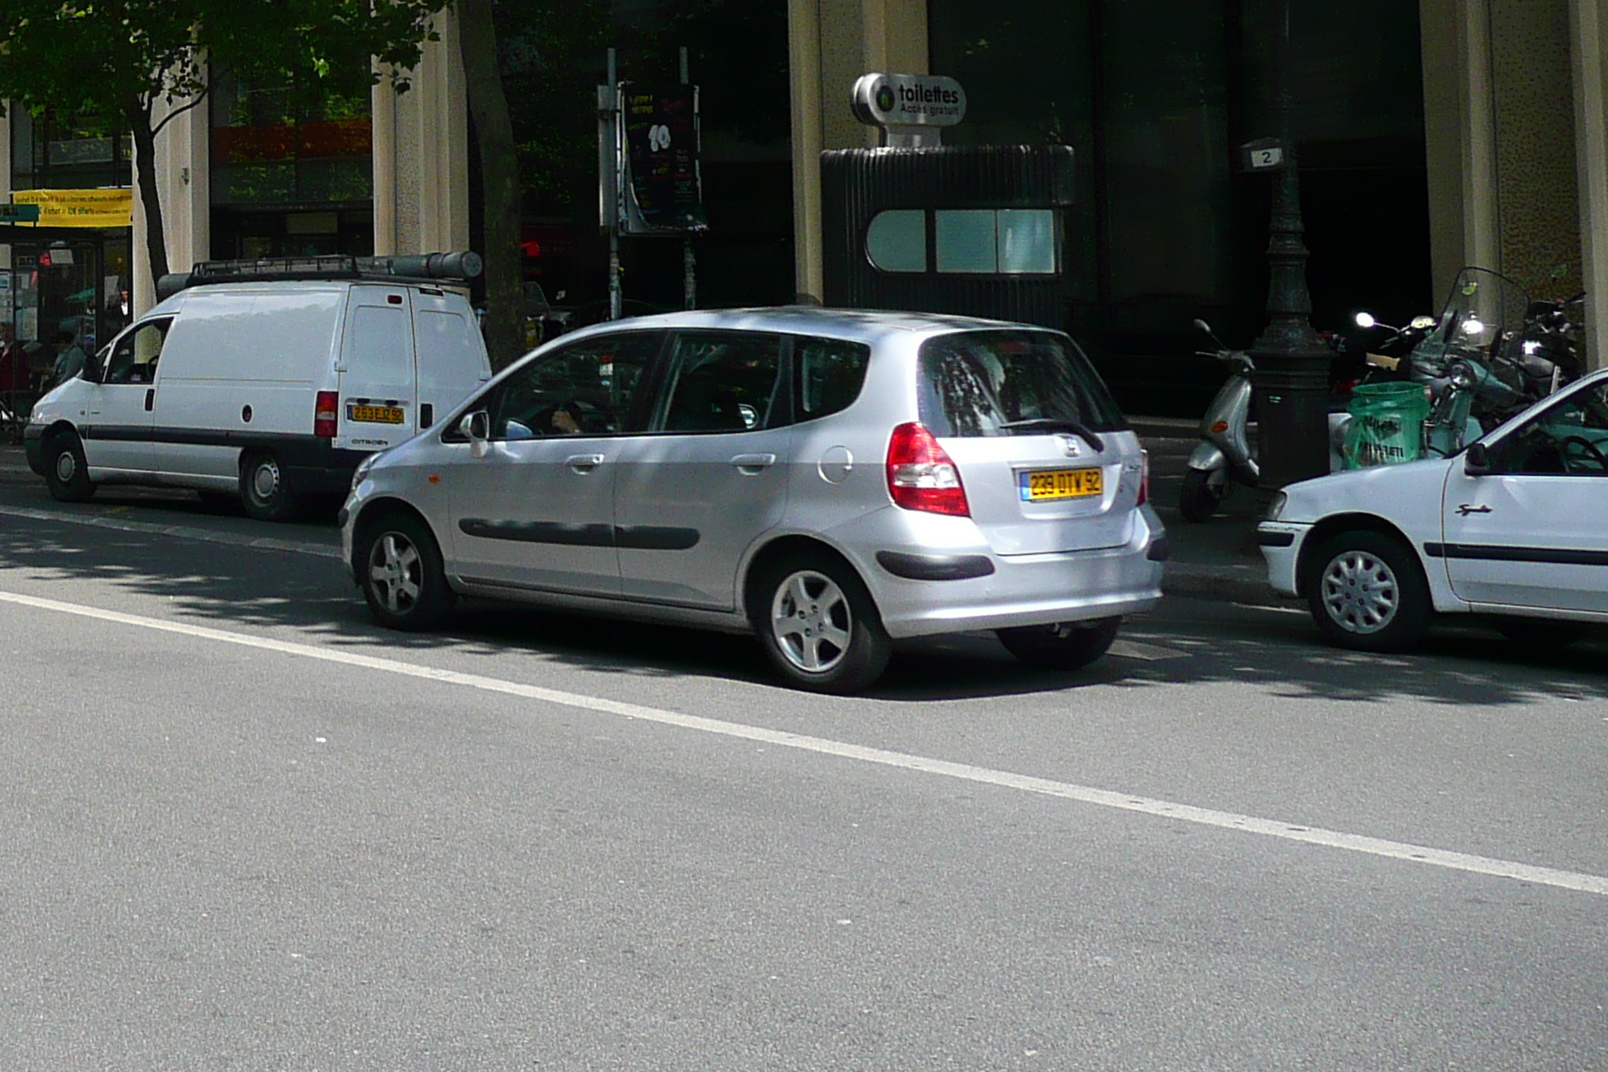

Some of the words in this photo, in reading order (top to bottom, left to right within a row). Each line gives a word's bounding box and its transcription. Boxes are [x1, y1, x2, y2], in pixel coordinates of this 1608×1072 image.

[899, 84, 959, 104] toilettes
[930, 106, 959, 117] gratuit
[1261, 151, 1272, 164] 2
[1086, 471, 1100, 491] 92
